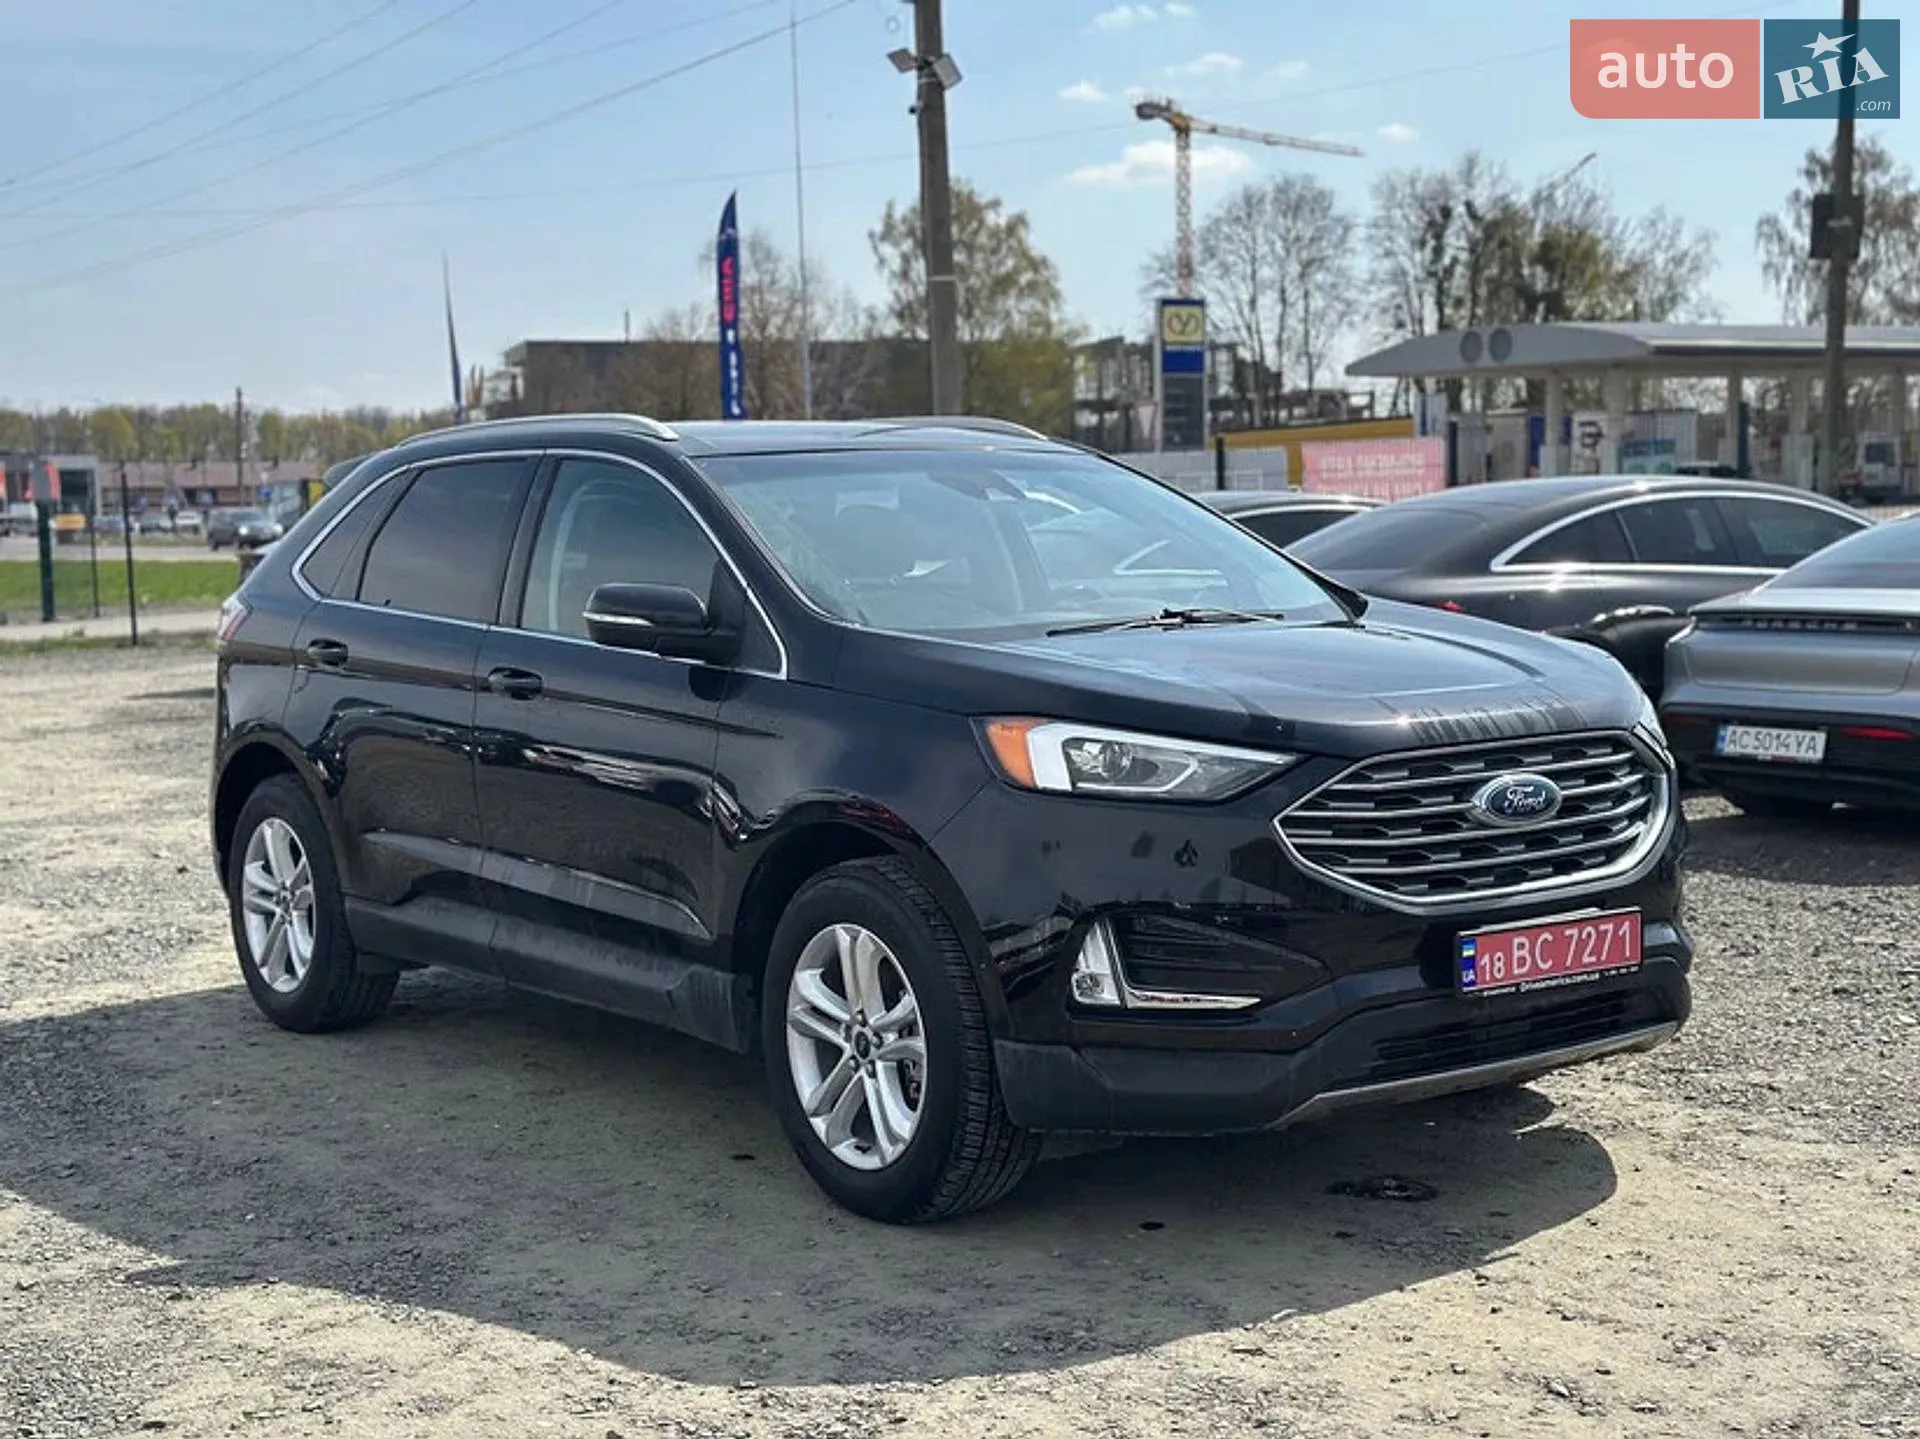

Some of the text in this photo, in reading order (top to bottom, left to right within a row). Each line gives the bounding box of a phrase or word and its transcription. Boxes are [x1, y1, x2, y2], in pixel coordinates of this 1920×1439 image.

[1726, 730, 1751, 750] AC
[1795, 734, 1818, 755] YA
[1505, 786, 1546, 814] Ford
[1480, 920, 1631, 981] 18 BC 7271
[1462, 969, 1476, 983] UA
